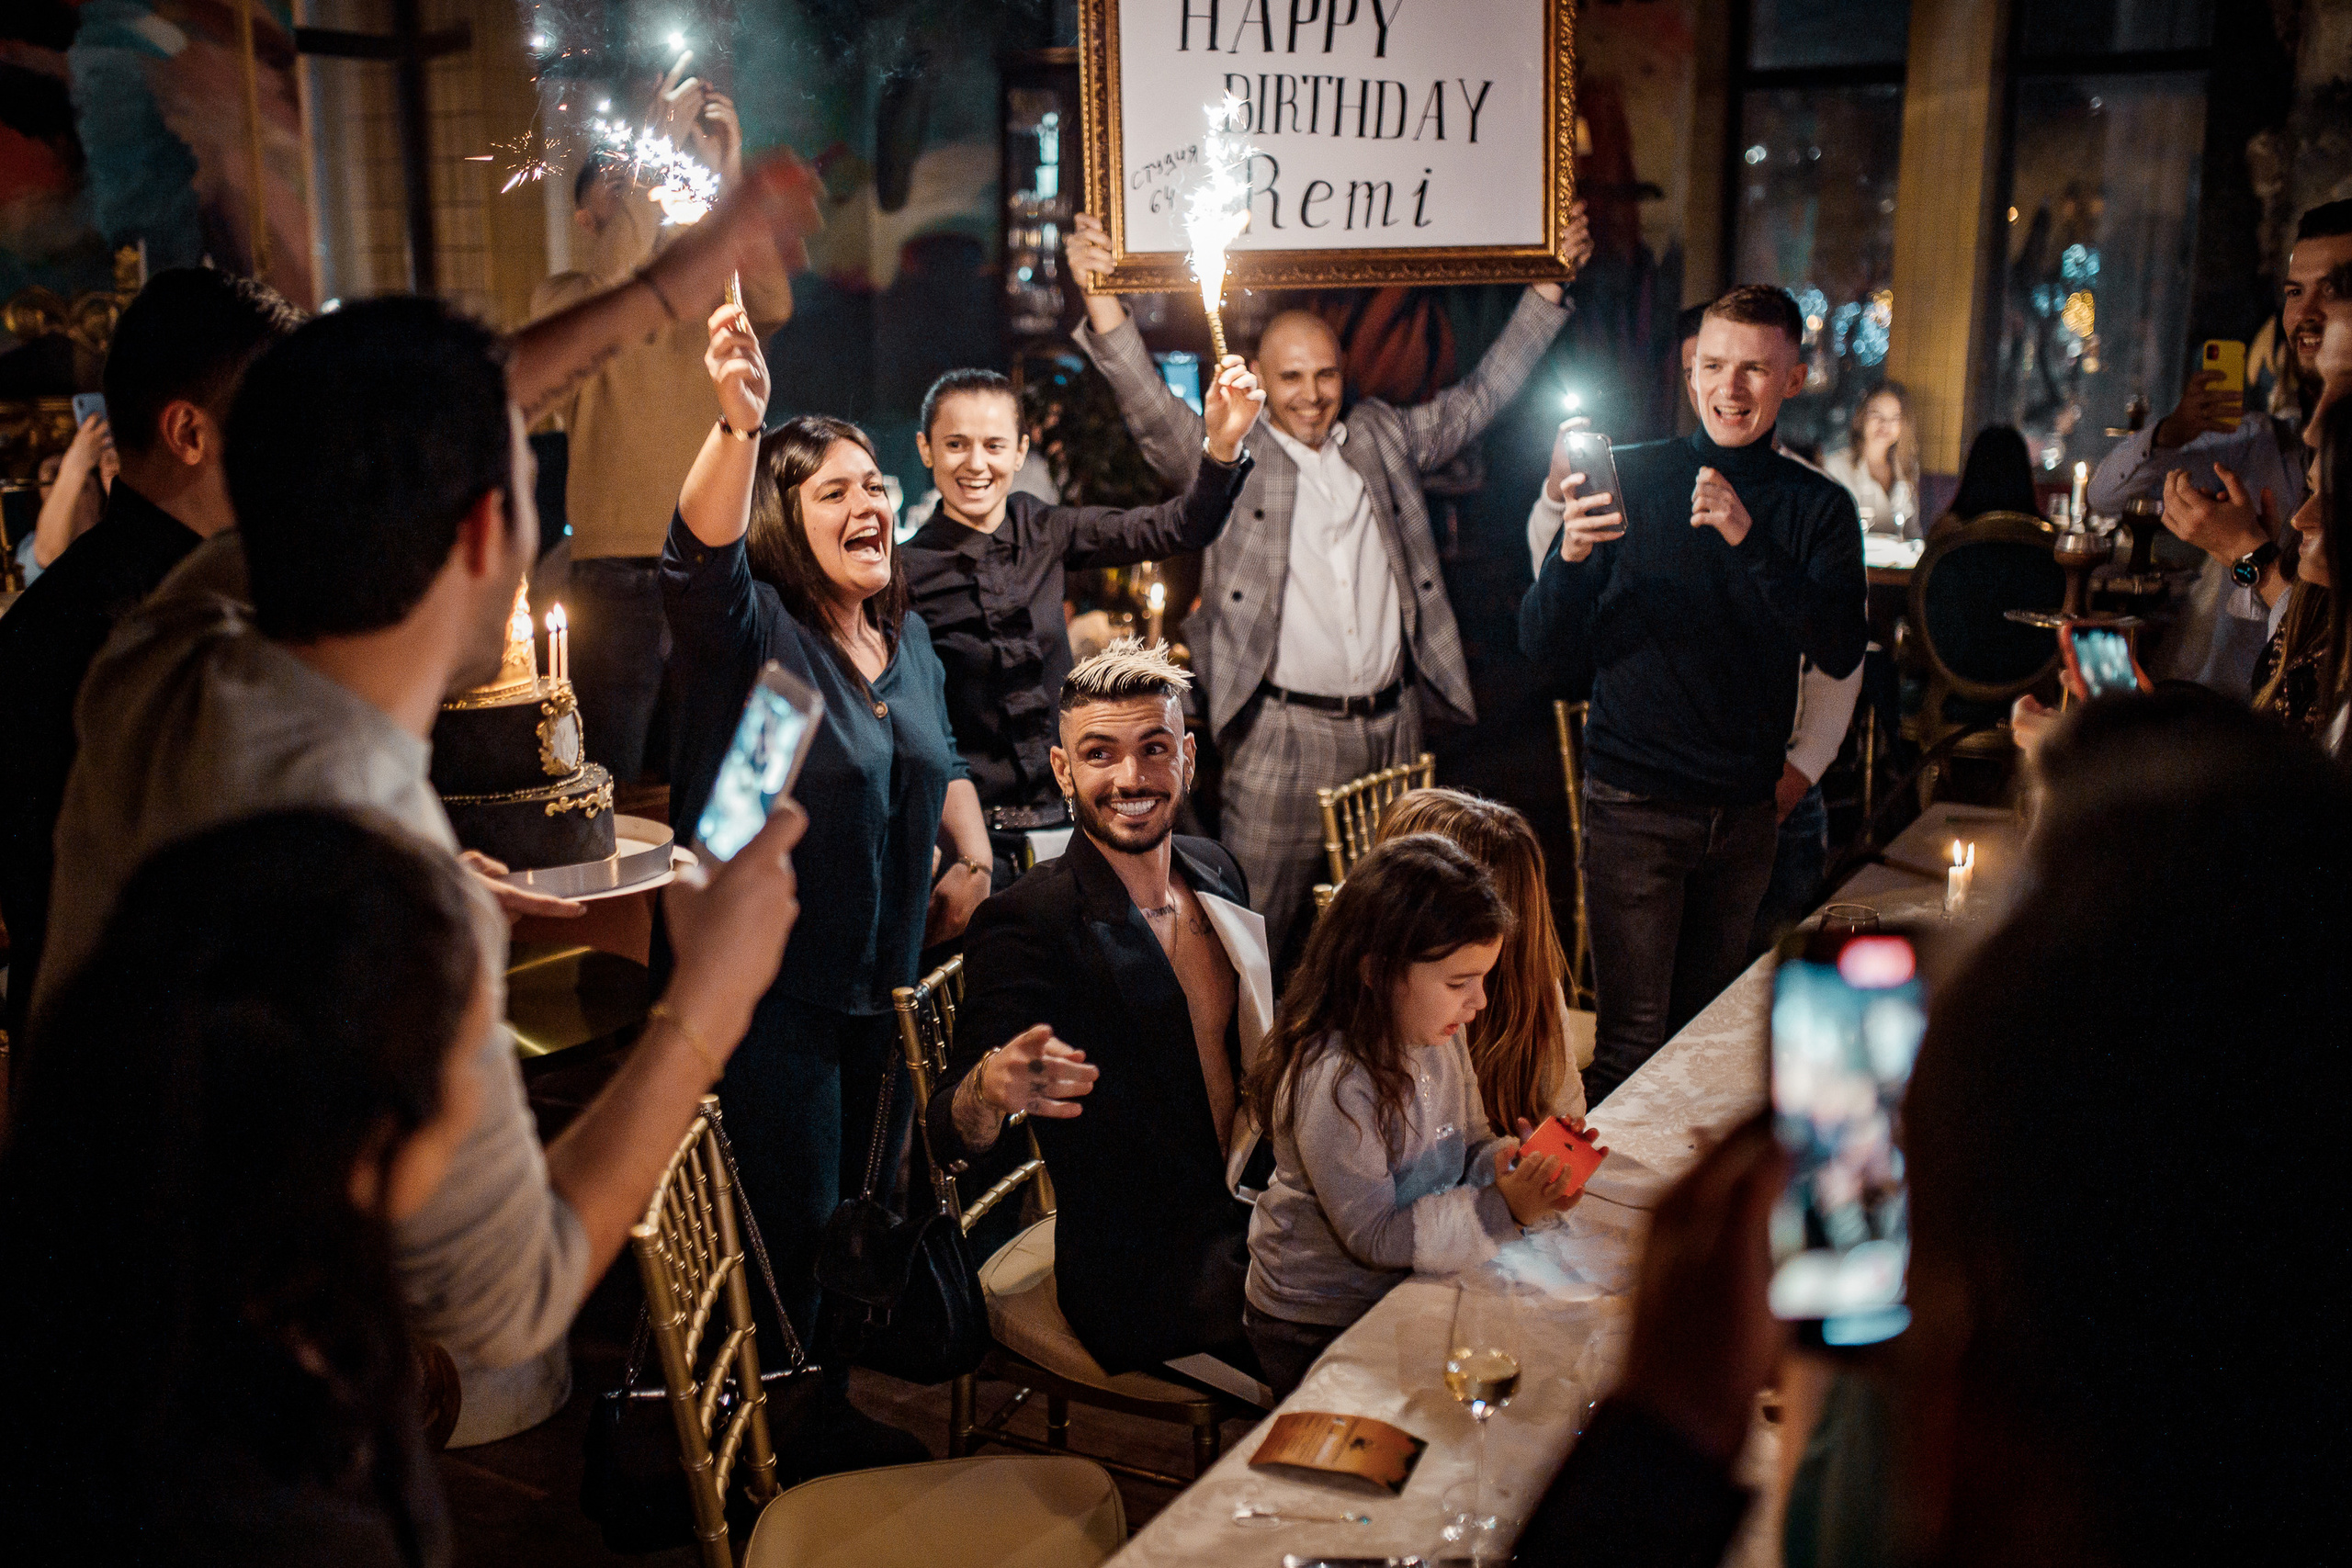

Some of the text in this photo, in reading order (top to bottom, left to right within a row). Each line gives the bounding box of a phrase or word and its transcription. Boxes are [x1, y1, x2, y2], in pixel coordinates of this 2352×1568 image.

[1177, 0, 1403, 58] HAPPY
[1223, 73, 1494, 143] BIRTHDAY
[1149, 185, 1176, 213] 64
[1244, 152, 1432, 233] Remi
